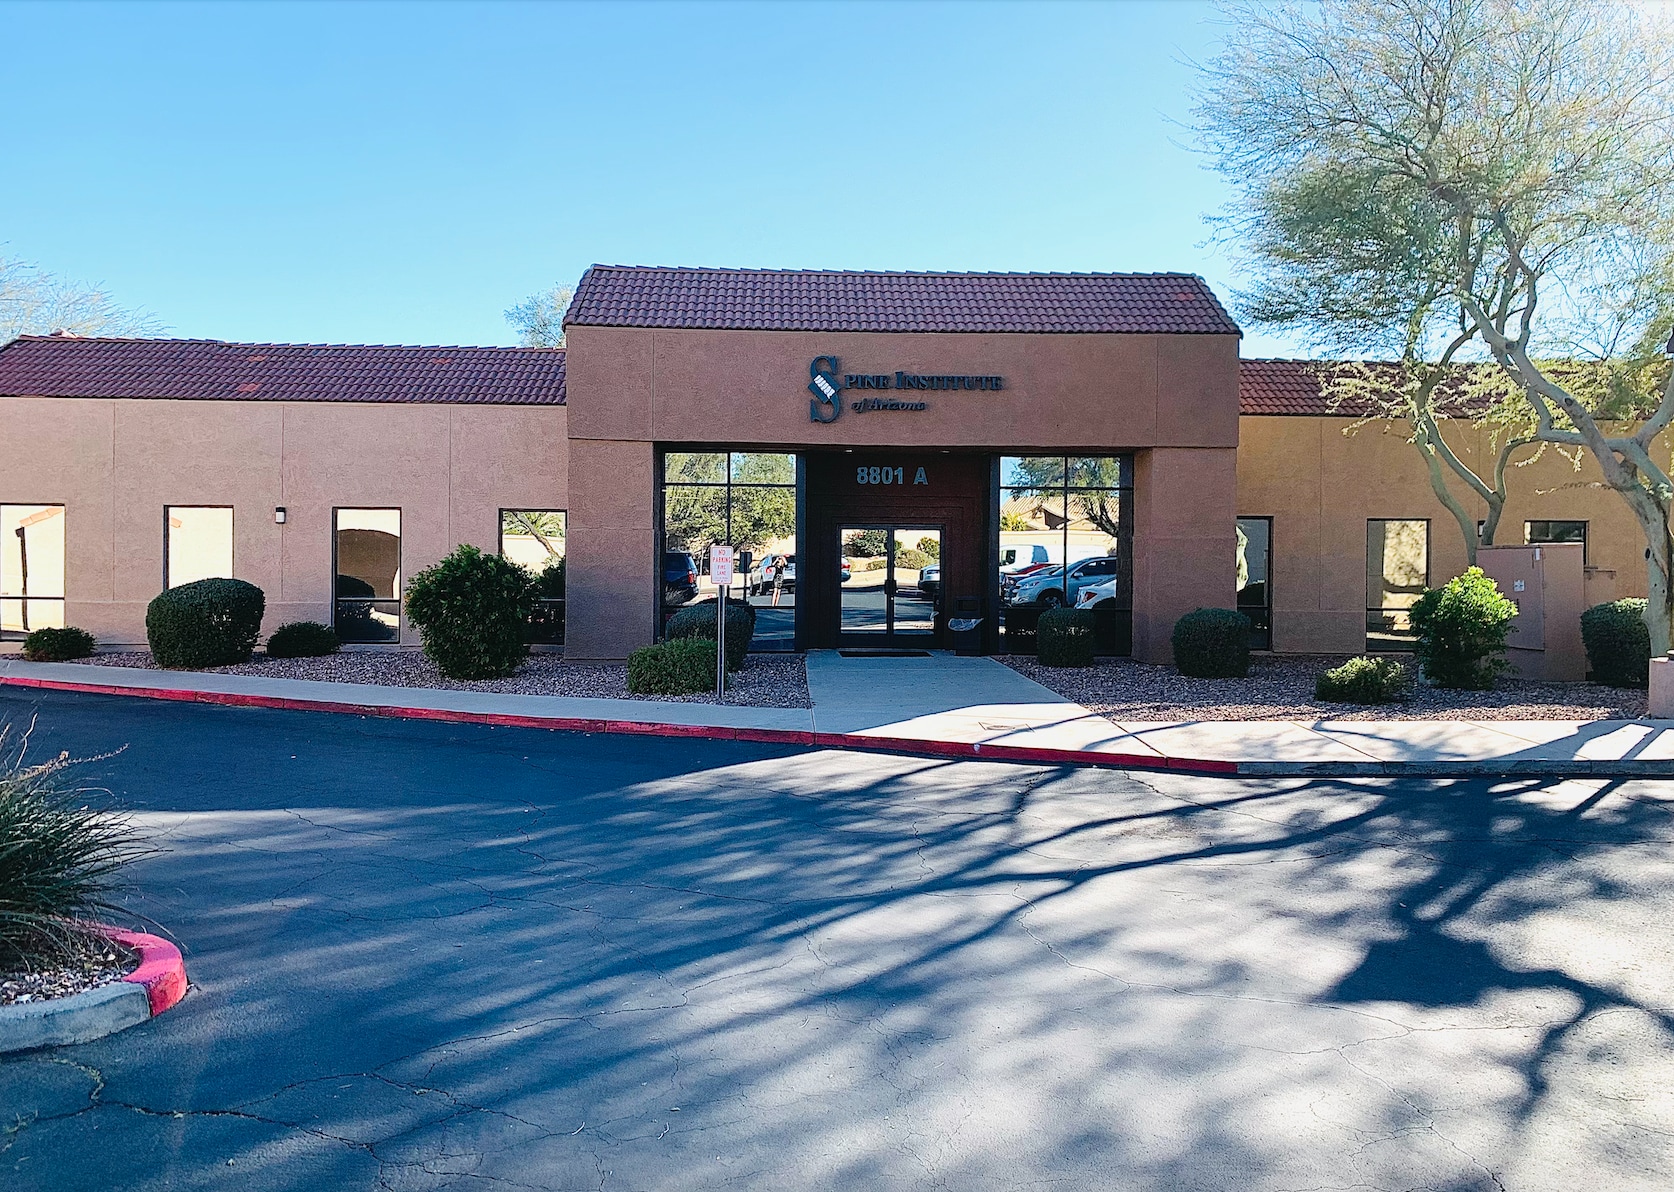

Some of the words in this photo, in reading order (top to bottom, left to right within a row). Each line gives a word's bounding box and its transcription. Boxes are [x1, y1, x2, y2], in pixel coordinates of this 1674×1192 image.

[894, 371, 1004, 390] INSTITUTE
[851, 398, 867, 413] of
[868, 398, 927, 411] Arizona
[856, 466, 904, 485] 8801
[912, 466, 929, 486] A
